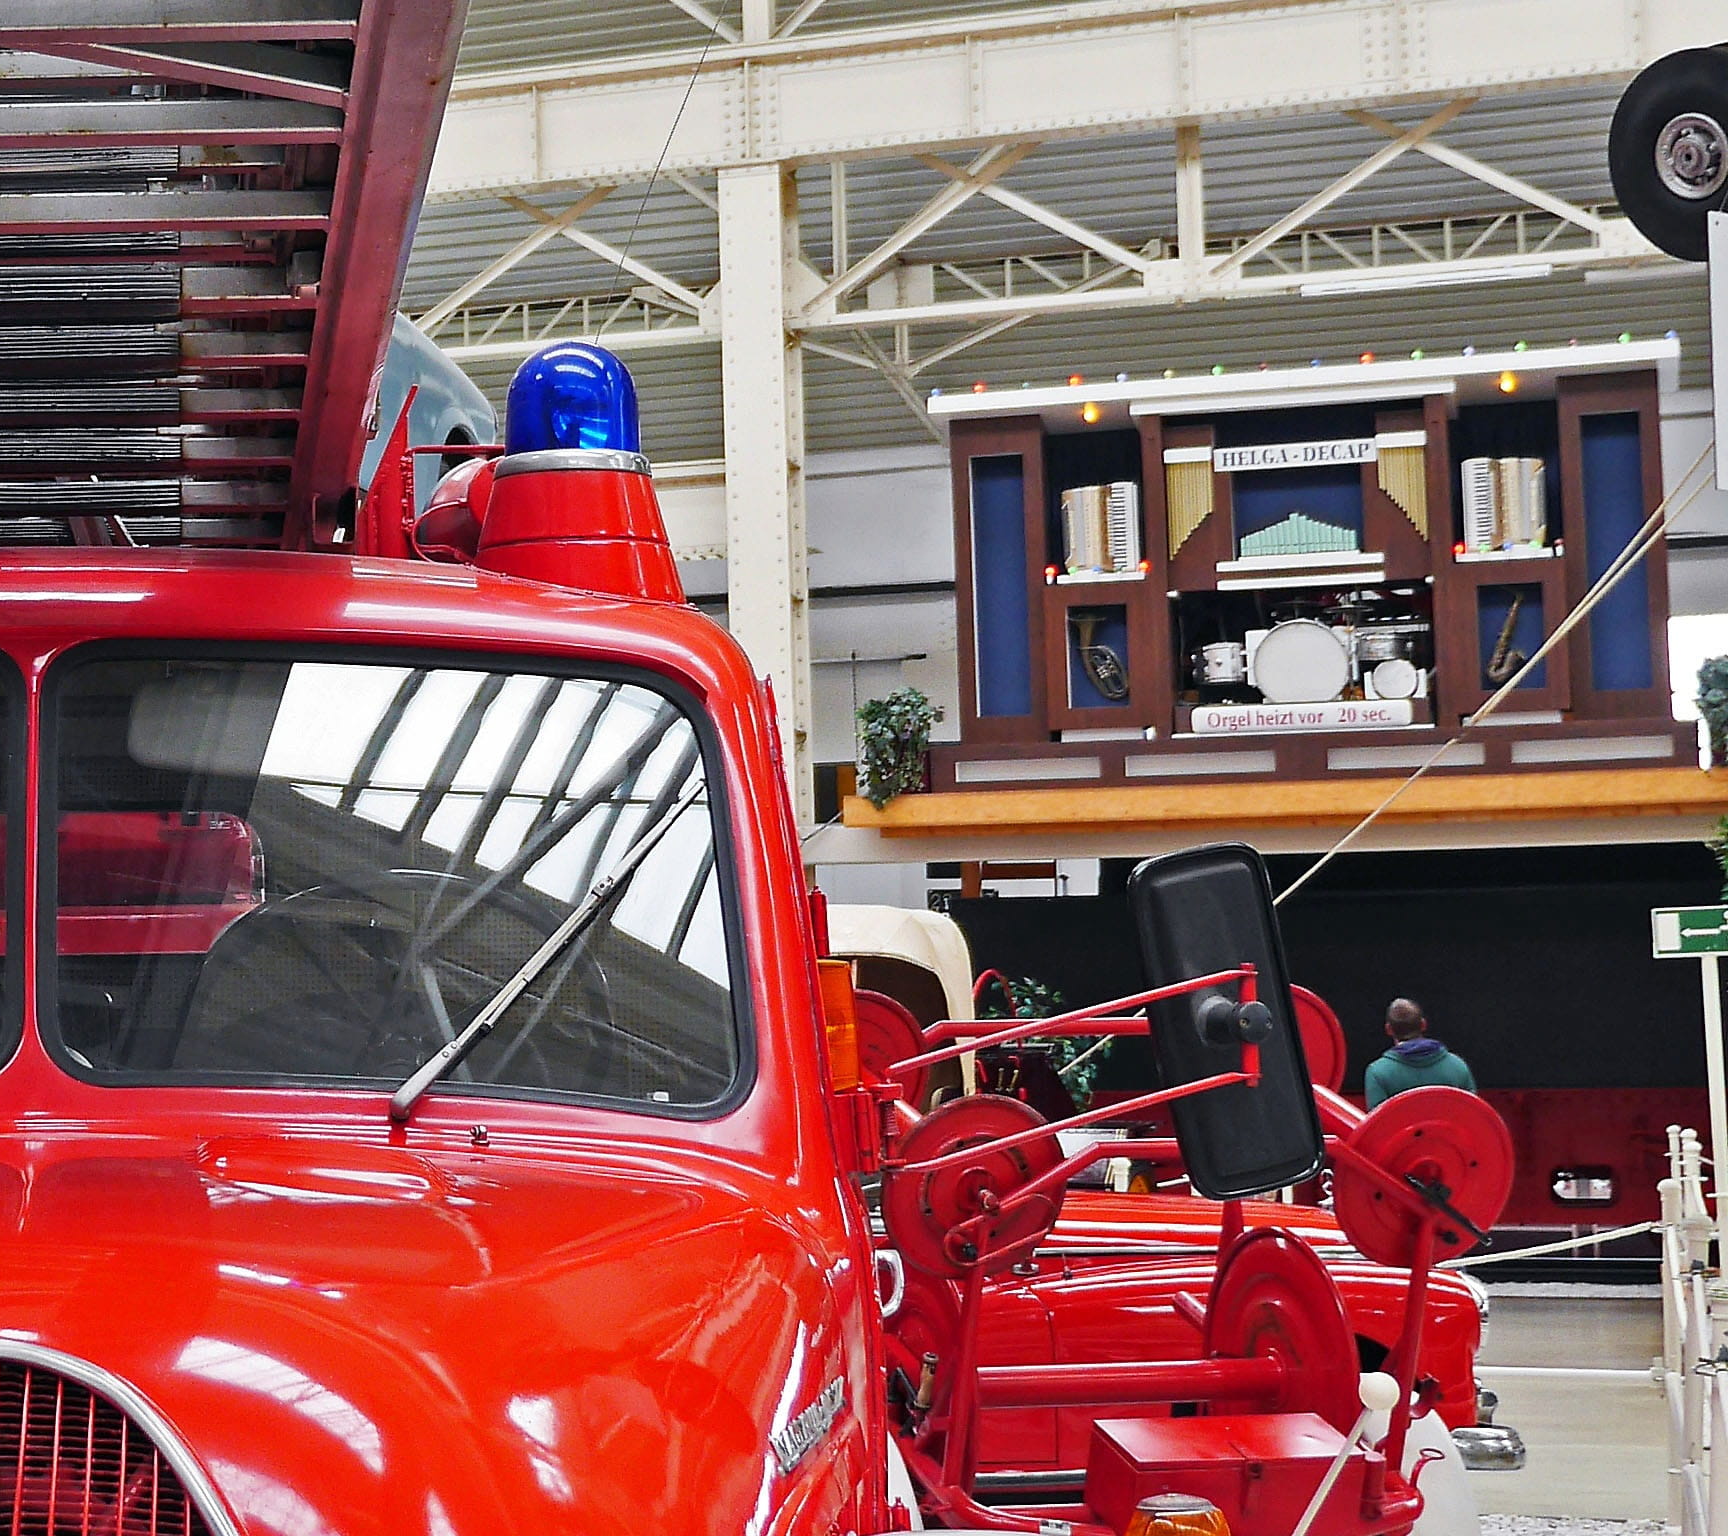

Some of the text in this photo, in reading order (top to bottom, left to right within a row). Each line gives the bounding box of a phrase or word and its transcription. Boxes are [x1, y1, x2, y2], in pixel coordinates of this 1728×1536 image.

[1222, 448, 1289, 467] HELGA
[1303, 442, 1370, 462] DECAP
[1207, 707, 1392, 731] Orgel heizt vor 20 sec.
